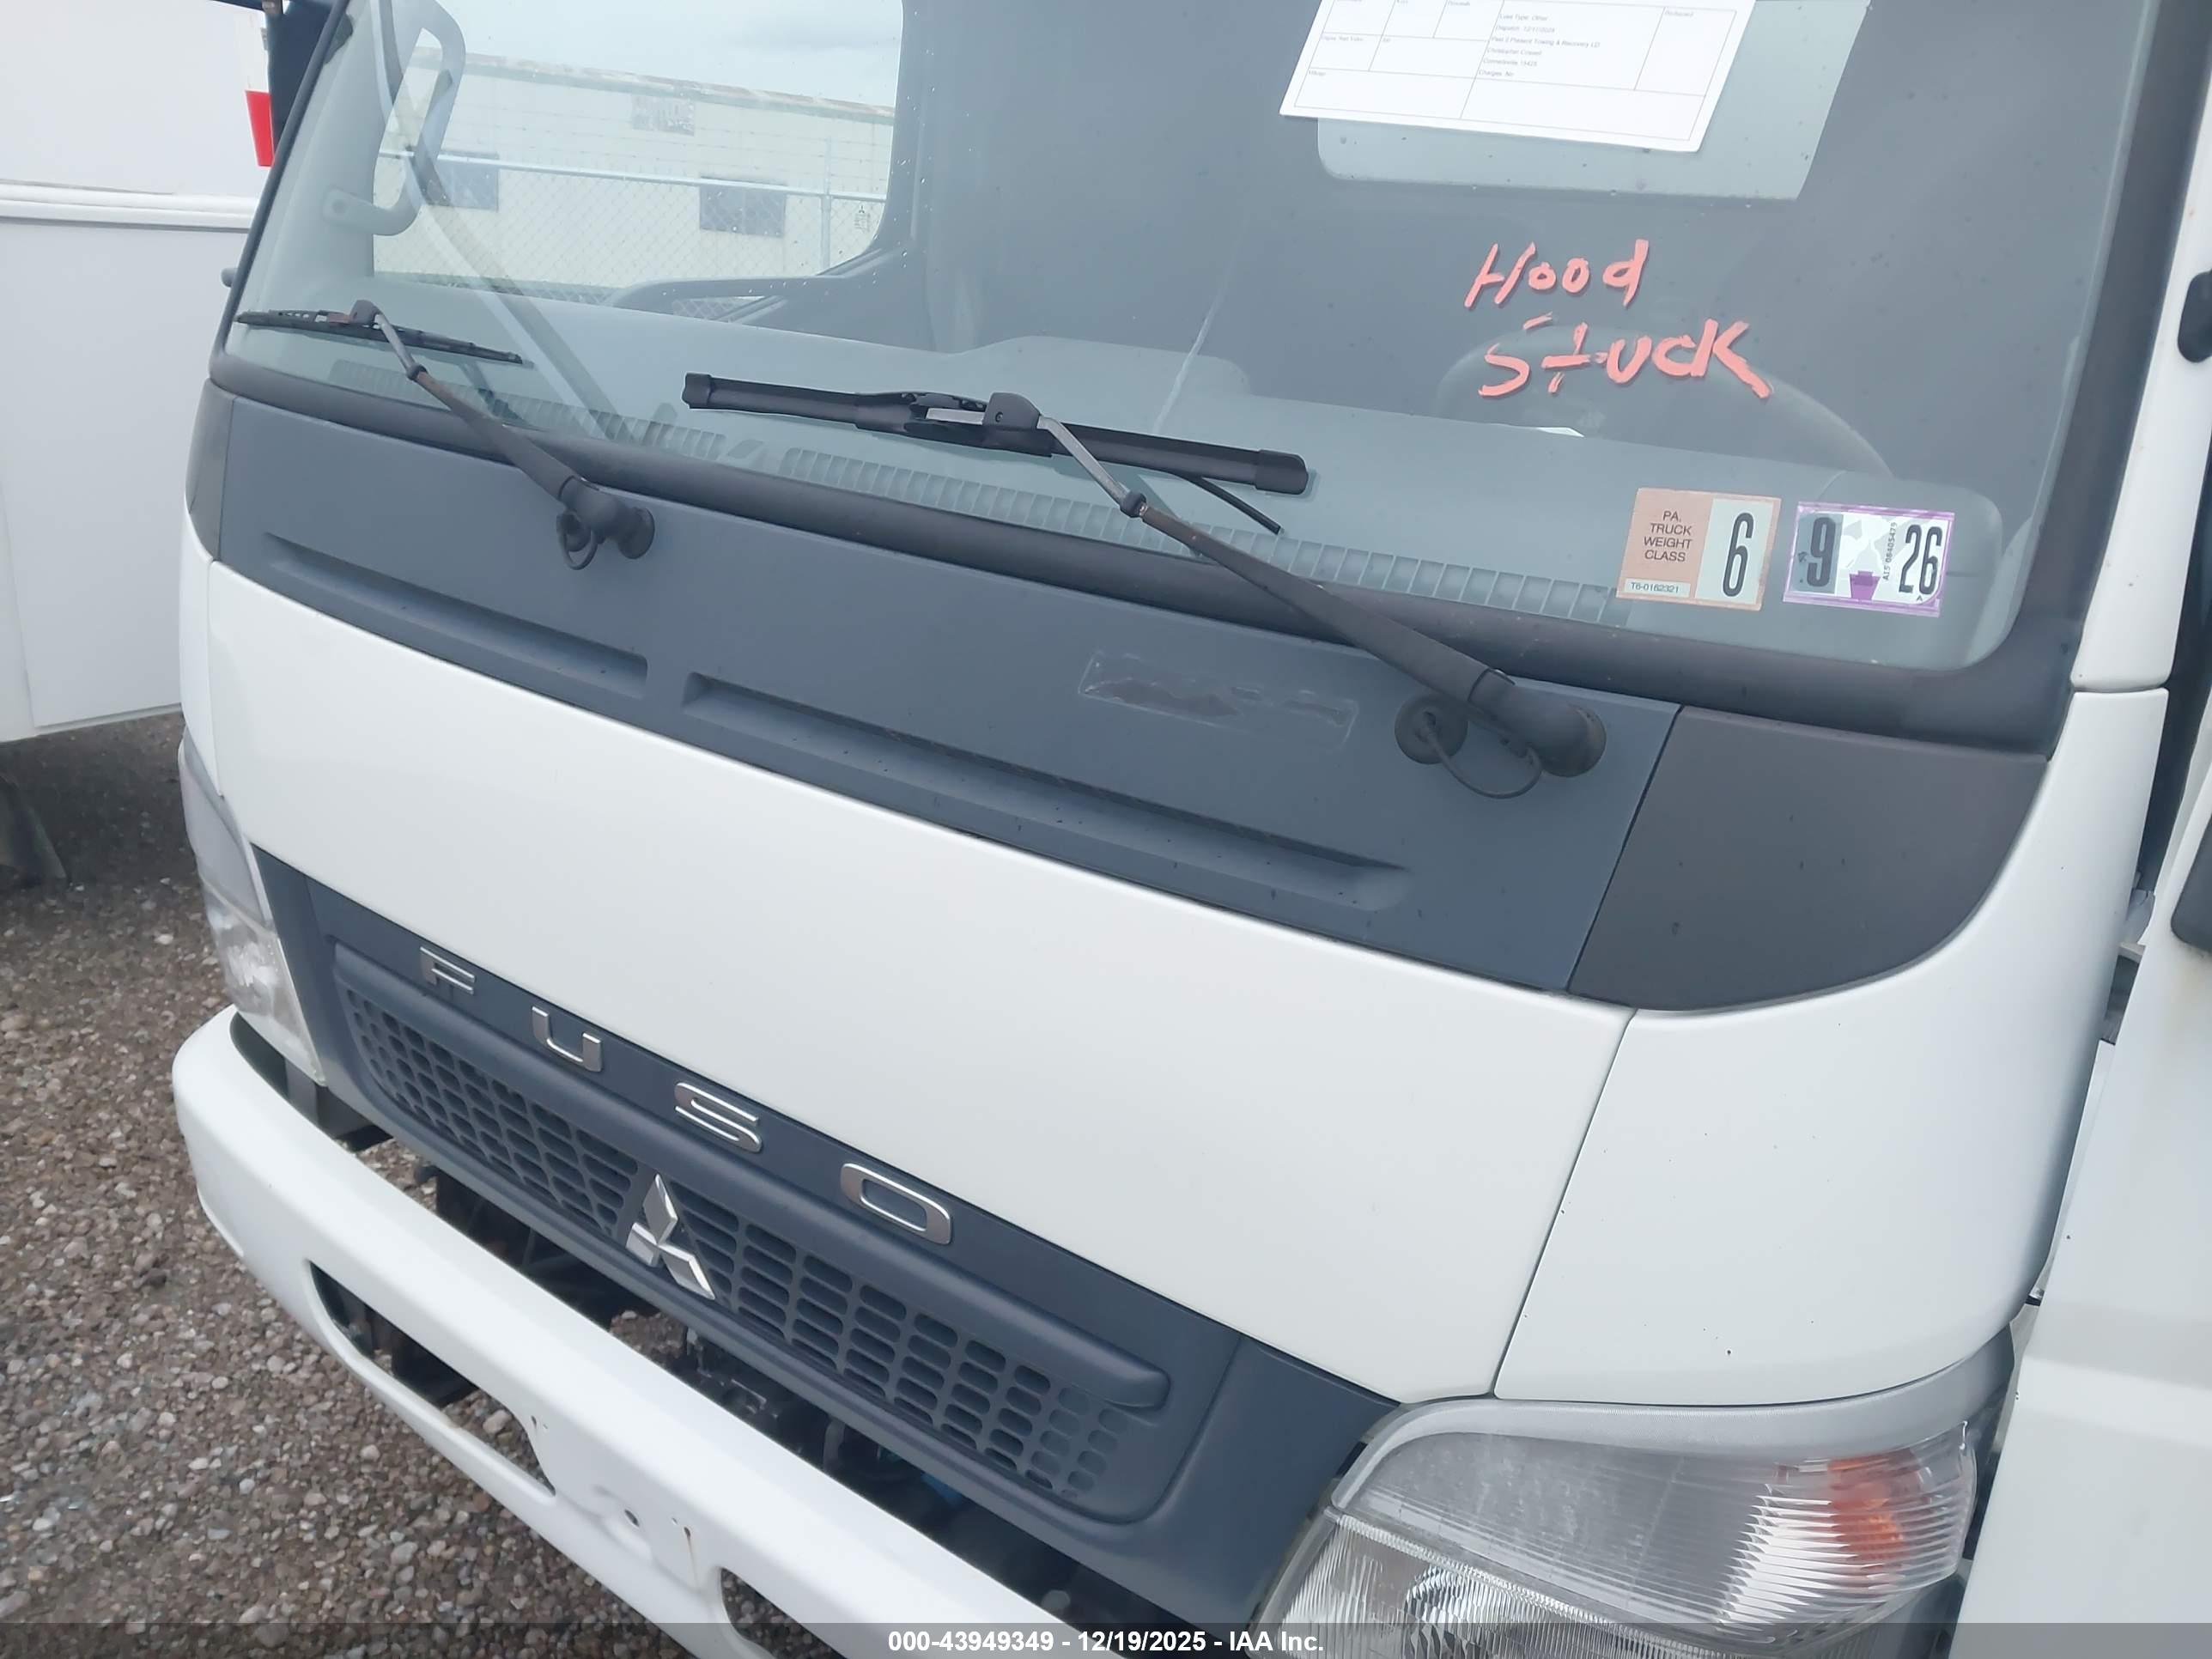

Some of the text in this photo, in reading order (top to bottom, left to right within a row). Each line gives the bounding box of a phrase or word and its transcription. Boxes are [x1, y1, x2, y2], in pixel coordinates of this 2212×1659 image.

[1464, 239, 1649, 307] Hood
[1644, 536, 1692, 550] WEIGHT
[1644, 550, 1686, 562] CLASS
[1650, 523, 1692, 536] TRUCK
[1723, 512, 1754, 598] 6
[1807, 517, 1836, 587] 9
[1899, 524, 1943, 595] 26
[419, 945, 954, 1246] FUSO
